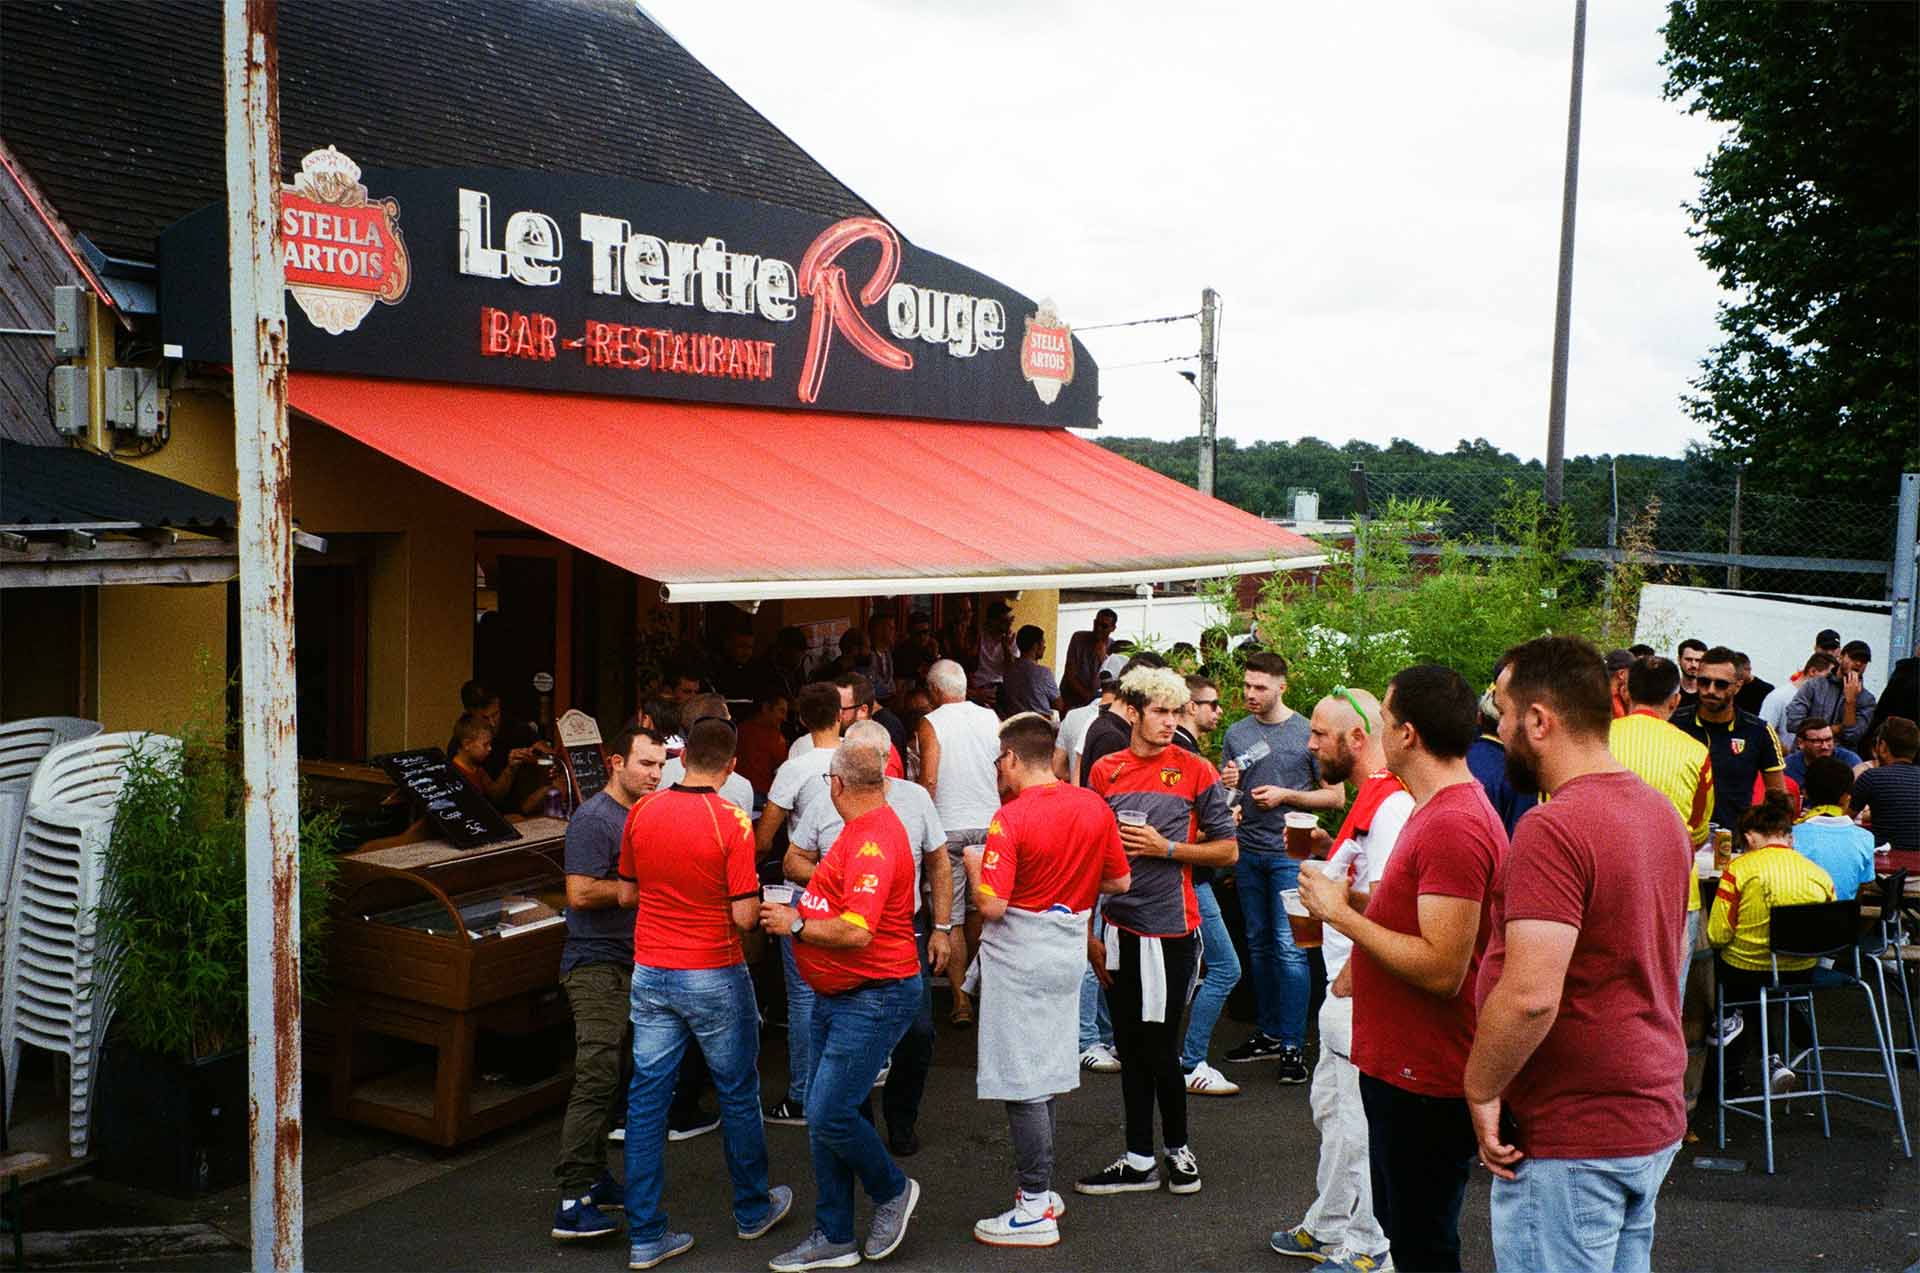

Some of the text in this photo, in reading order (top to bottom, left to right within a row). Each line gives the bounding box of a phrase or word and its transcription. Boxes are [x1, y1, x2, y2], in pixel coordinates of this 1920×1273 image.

[282, 207, 385, 248] STELLA
[283, 240, 385, 279] ARTOIS
[458, 187, 1006, 404] Le Tertre Rouge
[480, 307, 557, 361] BAR
[584, 318, 776, 380] RESTAURANT
[1030, 332, 1066, 353] STELLA
[1030, 351, 1066, 371] ARTOIS
